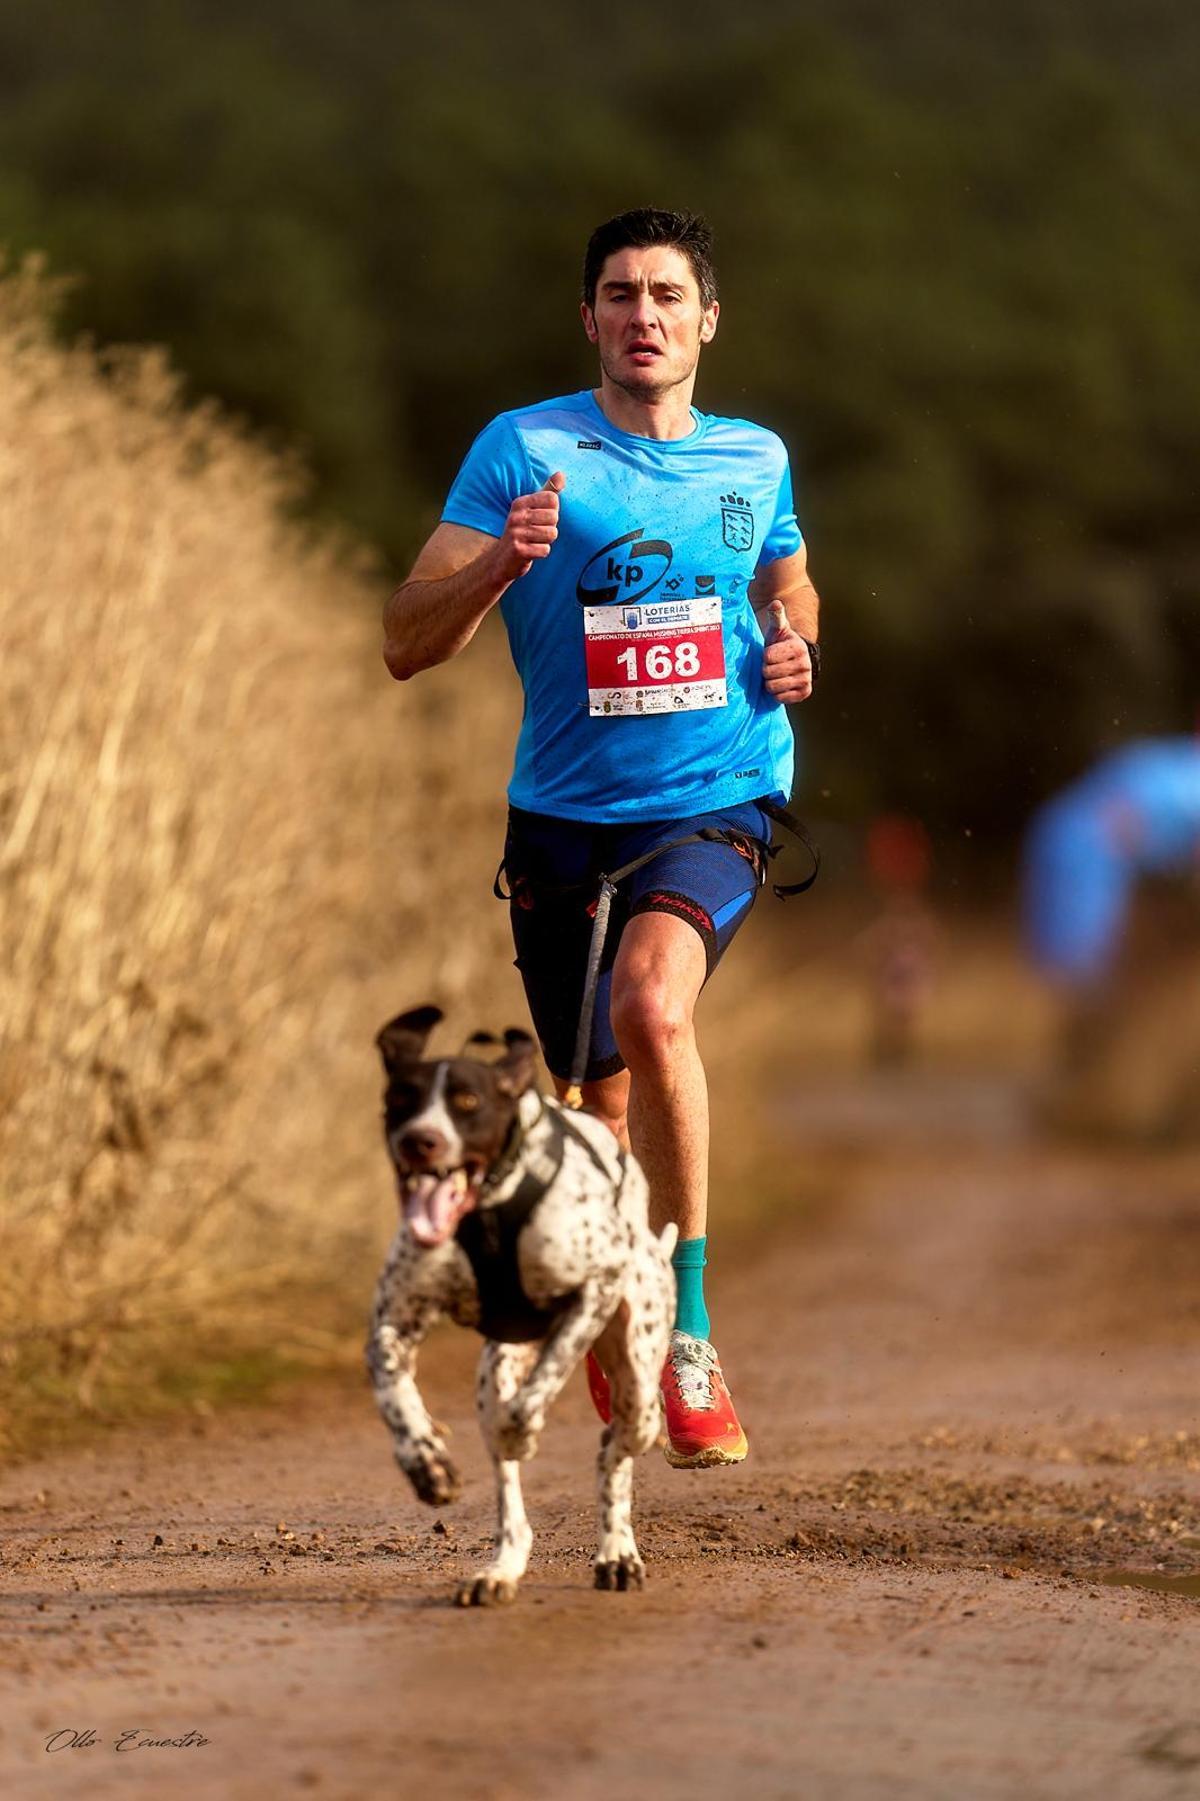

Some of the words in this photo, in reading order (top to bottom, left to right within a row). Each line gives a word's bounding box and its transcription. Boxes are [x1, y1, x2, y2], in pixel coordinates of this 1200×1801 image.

[607, 557, 644, 587] kp
[588, 632, 625, 641] CAMPEONATO
[617, 641, 701, 681] 168
